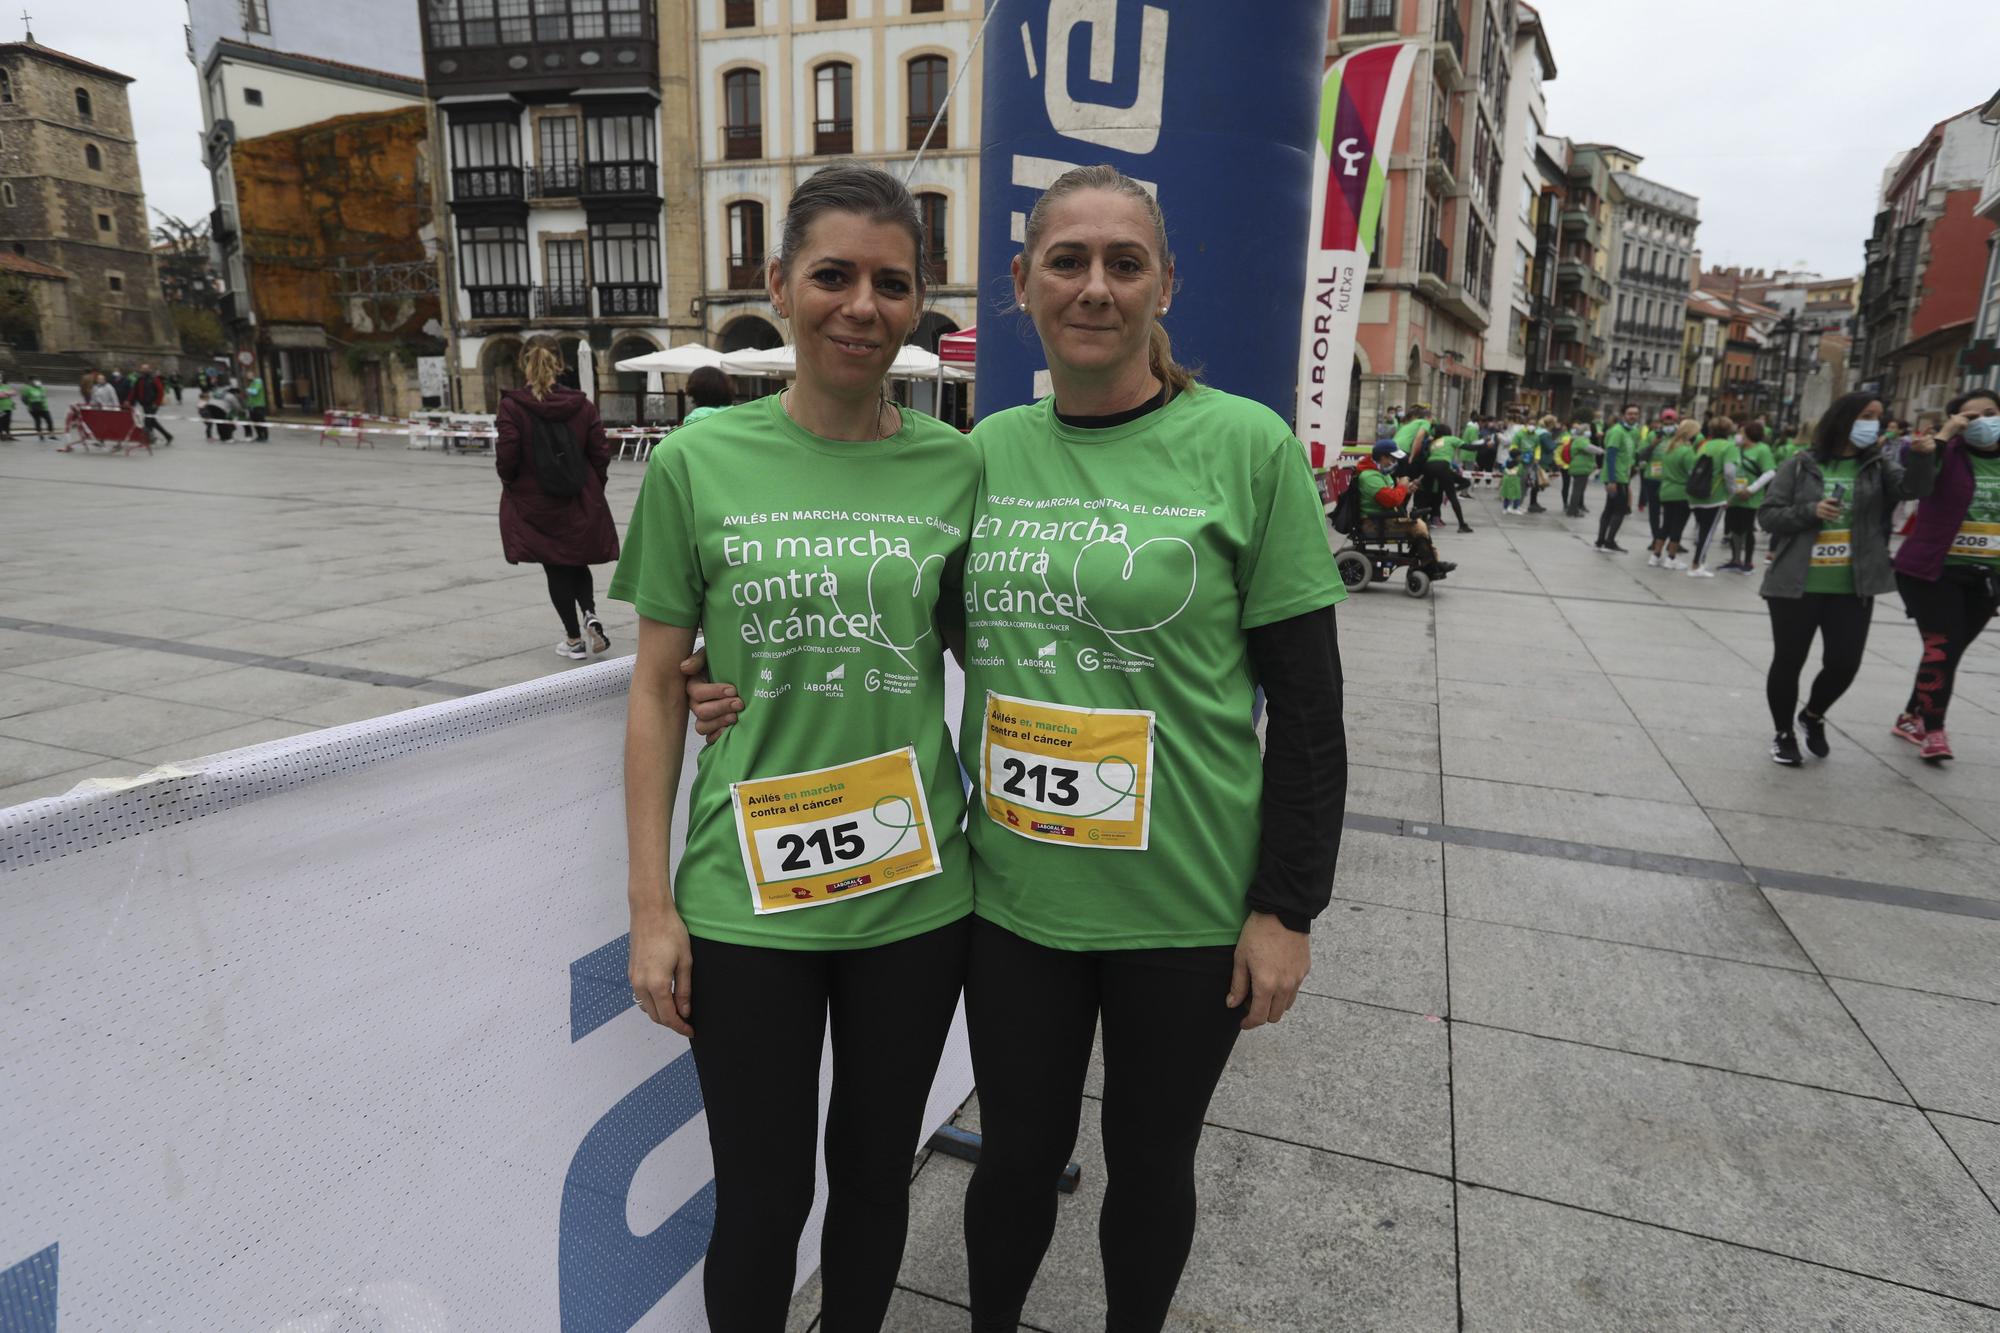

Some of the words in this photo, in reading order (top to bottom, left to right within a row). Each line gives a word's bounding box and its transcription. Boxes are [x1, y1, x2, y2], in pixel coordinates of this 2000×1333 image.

[1336, 267, 1354, 312] kutxa
[986, 494, 1015, 506] VILÉS
[1017, 498, 1034, 508] EN
[1036, 497, 1080, 509] MARCHA
[1083, 498, 1130, 512] CONTRA
[1132, 504, 1149, 514] EL
[1152, 504, 1207, 518] CÁNCER
[723, 512, 768, 527] AVILÉS
[771, 511, 789, 522] EN
[792, 510, 850, 521] MARCHA
[853, 511, 905, 524] CONTRA
[907, 514, 924, 525] EL
[925, 514, 961, 537] CÁNCER
[971, 513, 1002, 539] En
[1008, 517, 1128, 544] marcha
[723, 535, 763, 567] En
[775, 529, 911, 559] marcha
[1816, 545, 1847, 556] 209
[1955, 535, 1988, 547] 208
[966, 547, 1050, 575] contra
[731, 568, 838, 607] contra
[964, 581, 980, 613] el
[983, 580, 1087, 617] cáncer
[826, 646, 835, 654] EL
[835, 645, 861, 654] CÁNCER
[1017, 658, 1056, 668] LABORAL
[803, 681, 844, 692] LABORAL
[991, 710, 1017, 725] Avilés
[1035, 720, 1078, 735] marcha
[990, 723, 1018, 739] contra
[1020, 731, 1031, 741] el
[1033, 733, 1073, 749] cáncer
[748, 794, 781, 806] Avilés
[783, 790, 798, 801] en
[799, 781, 846, 798] marcha
[1003, 757, 1080, 807] 213
[750, 804, 787, 819] contra
[788, 802, 800, 813] el
[801, 794, 844, 812] cáncer
[776, 821, 866, 872] 215
